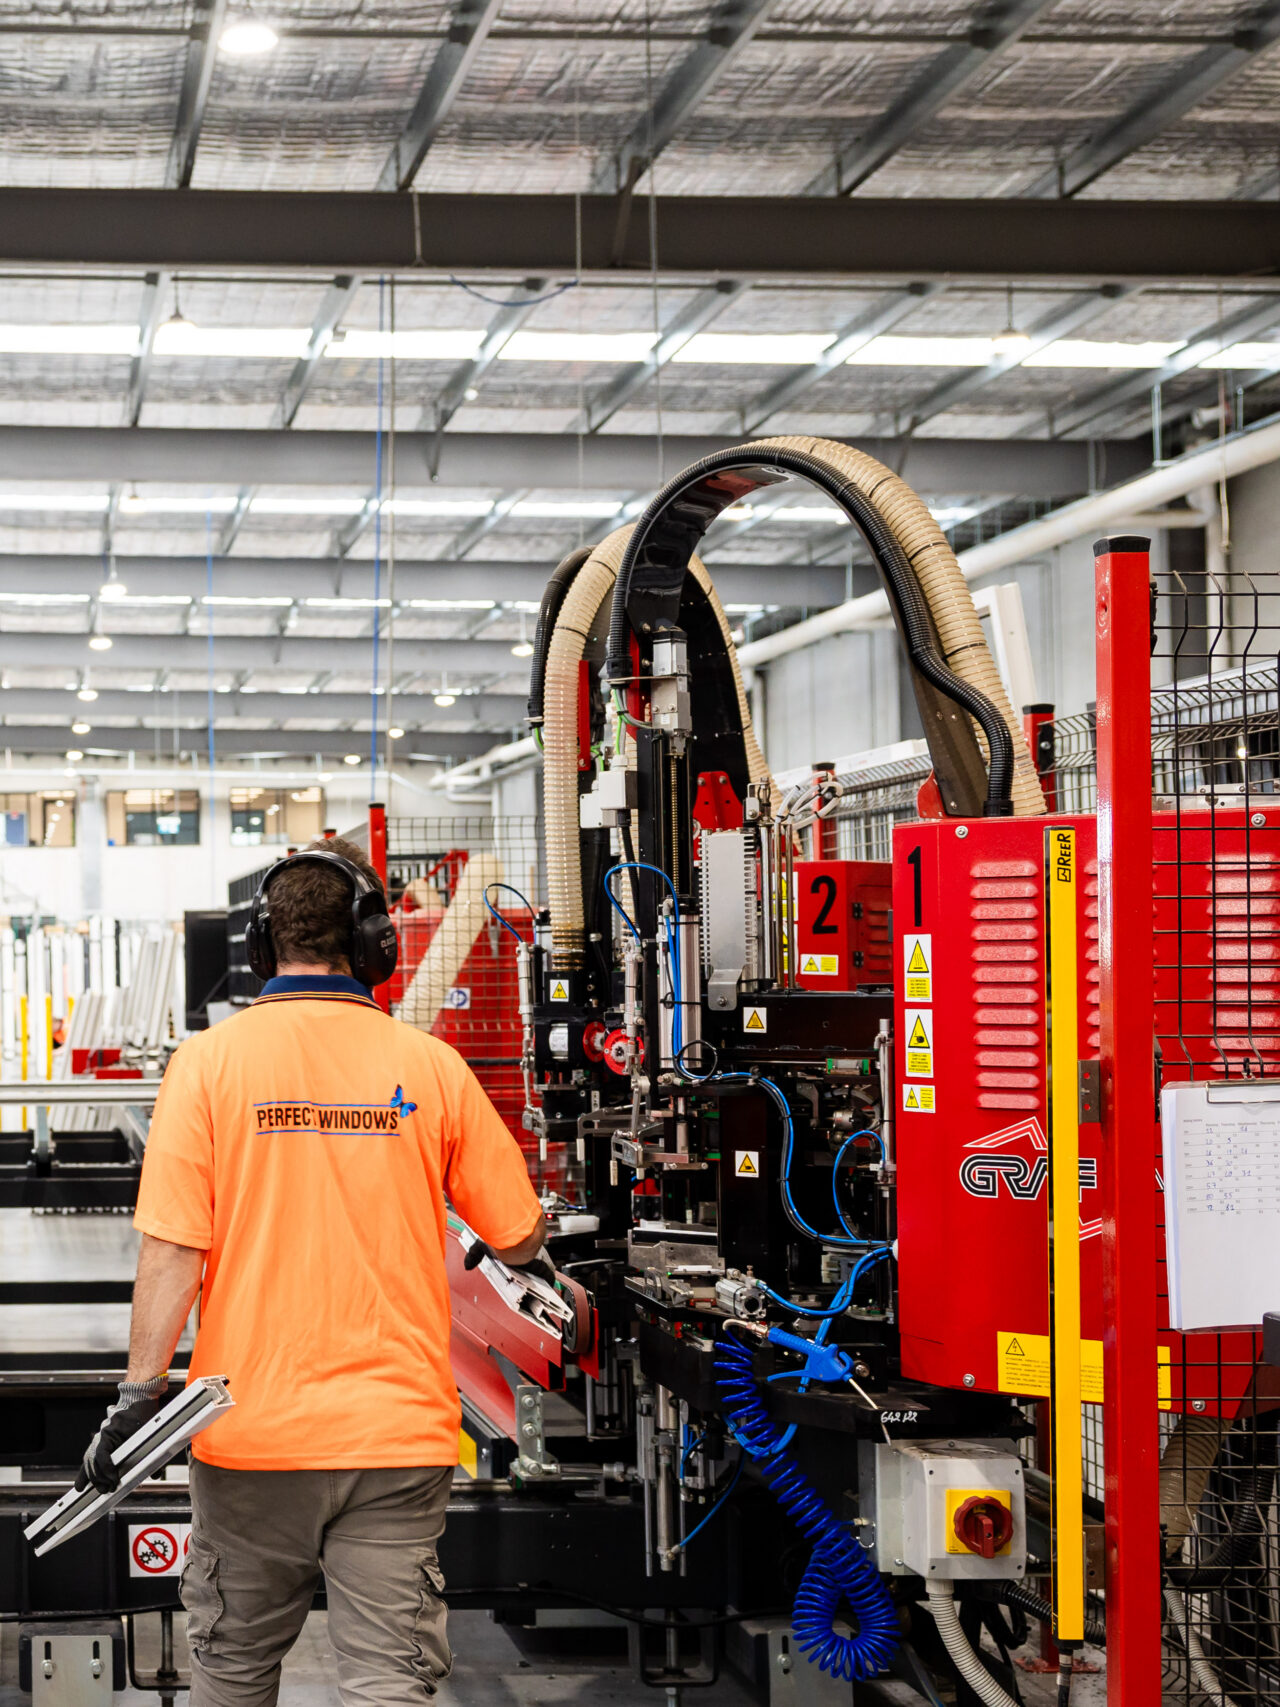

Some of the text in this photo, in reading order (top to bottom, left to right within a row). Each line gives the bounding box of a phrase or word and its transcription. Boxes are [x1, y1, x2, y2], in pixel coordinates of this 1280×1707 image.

[810, 875, 838, 934] 2
[907, 846, 922, 927] 1
[318, 1110, 398, 1129] WINDOWS
